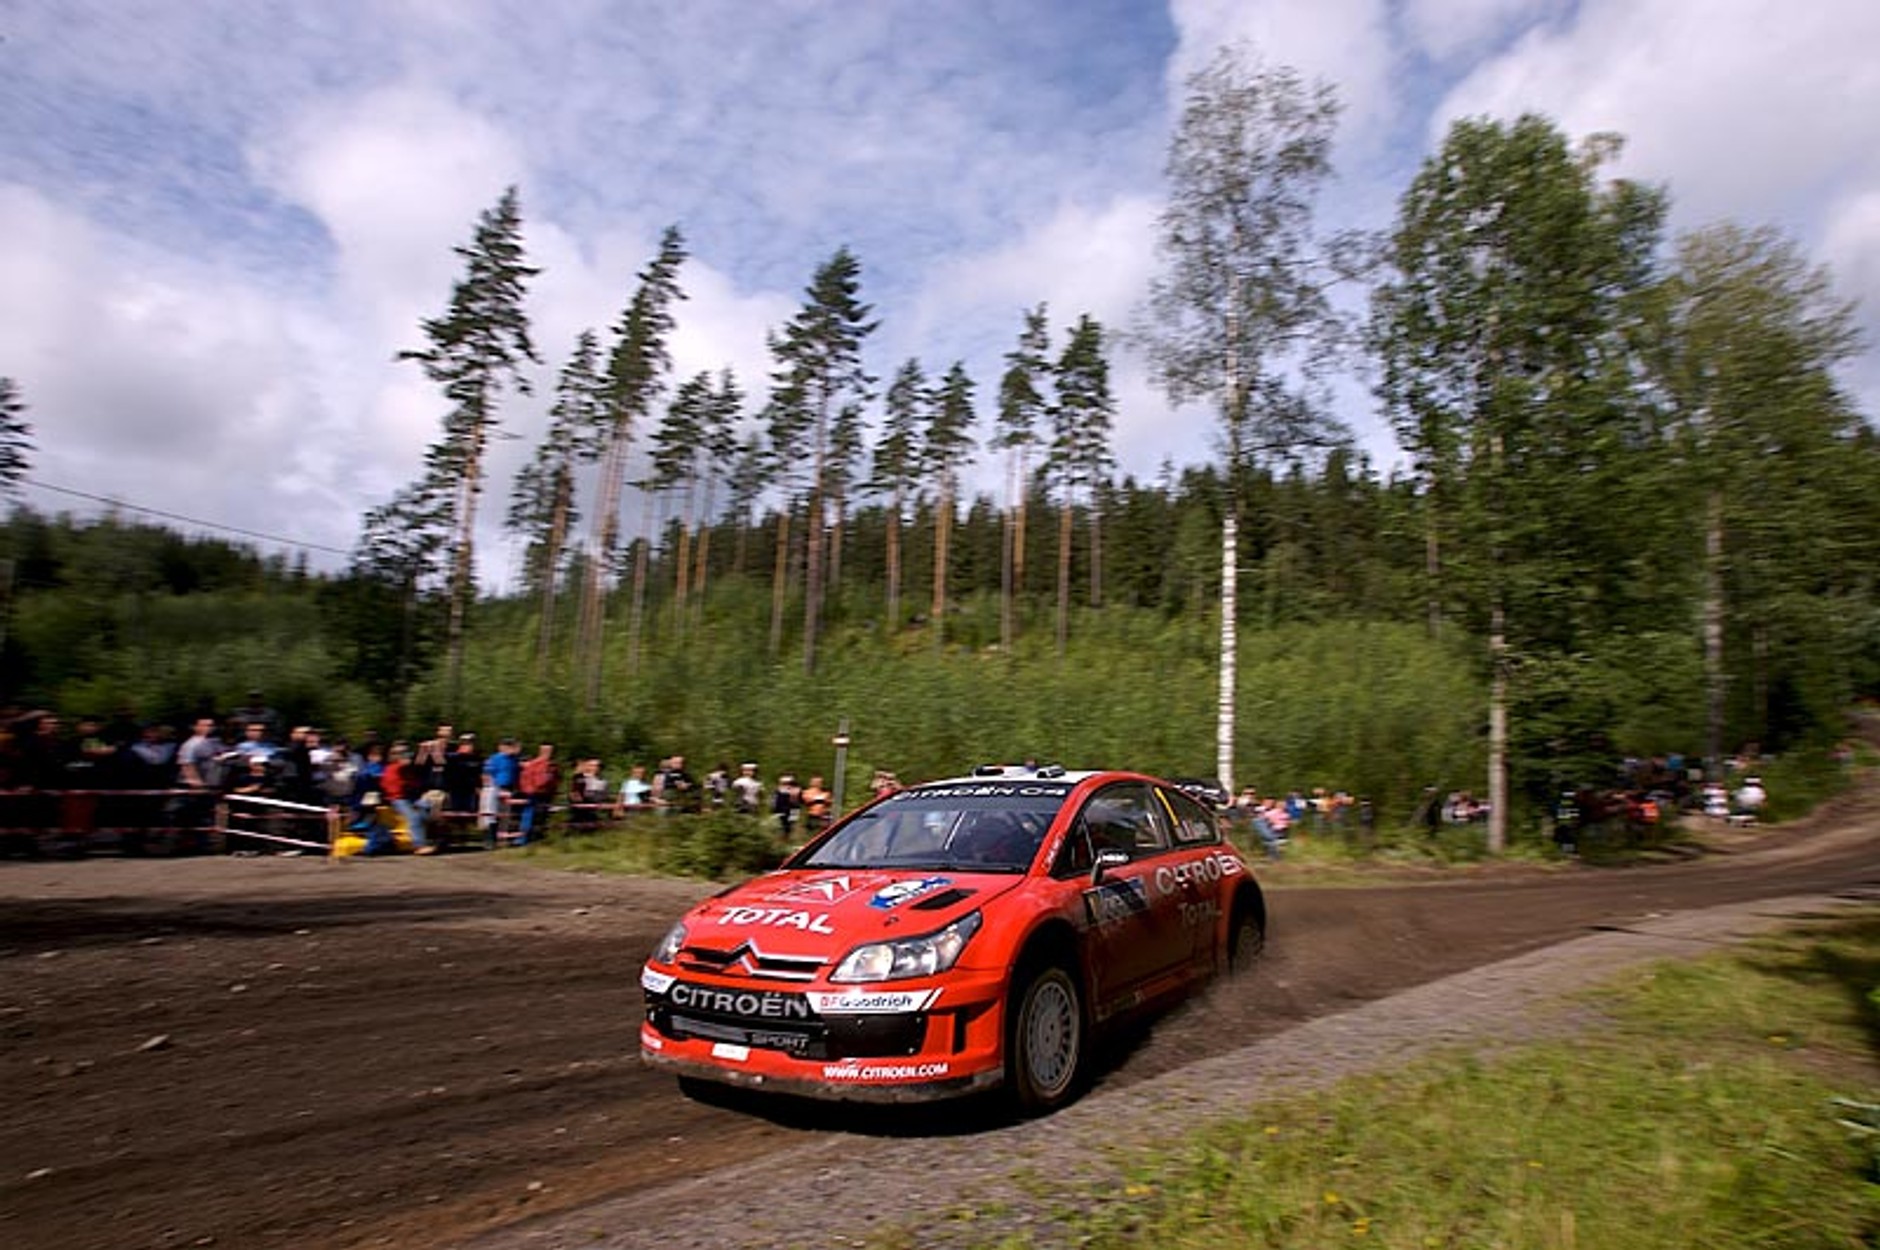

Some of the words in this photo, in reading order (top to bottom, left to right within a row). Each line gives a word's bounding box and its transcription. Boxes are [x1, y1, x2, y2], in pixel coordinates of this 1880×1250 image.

[717, 906, 834, 935] TOTAL
[671, 984, 808, 1018] CITROËN
[820, 995, 913, 1007] BFGoodrich
